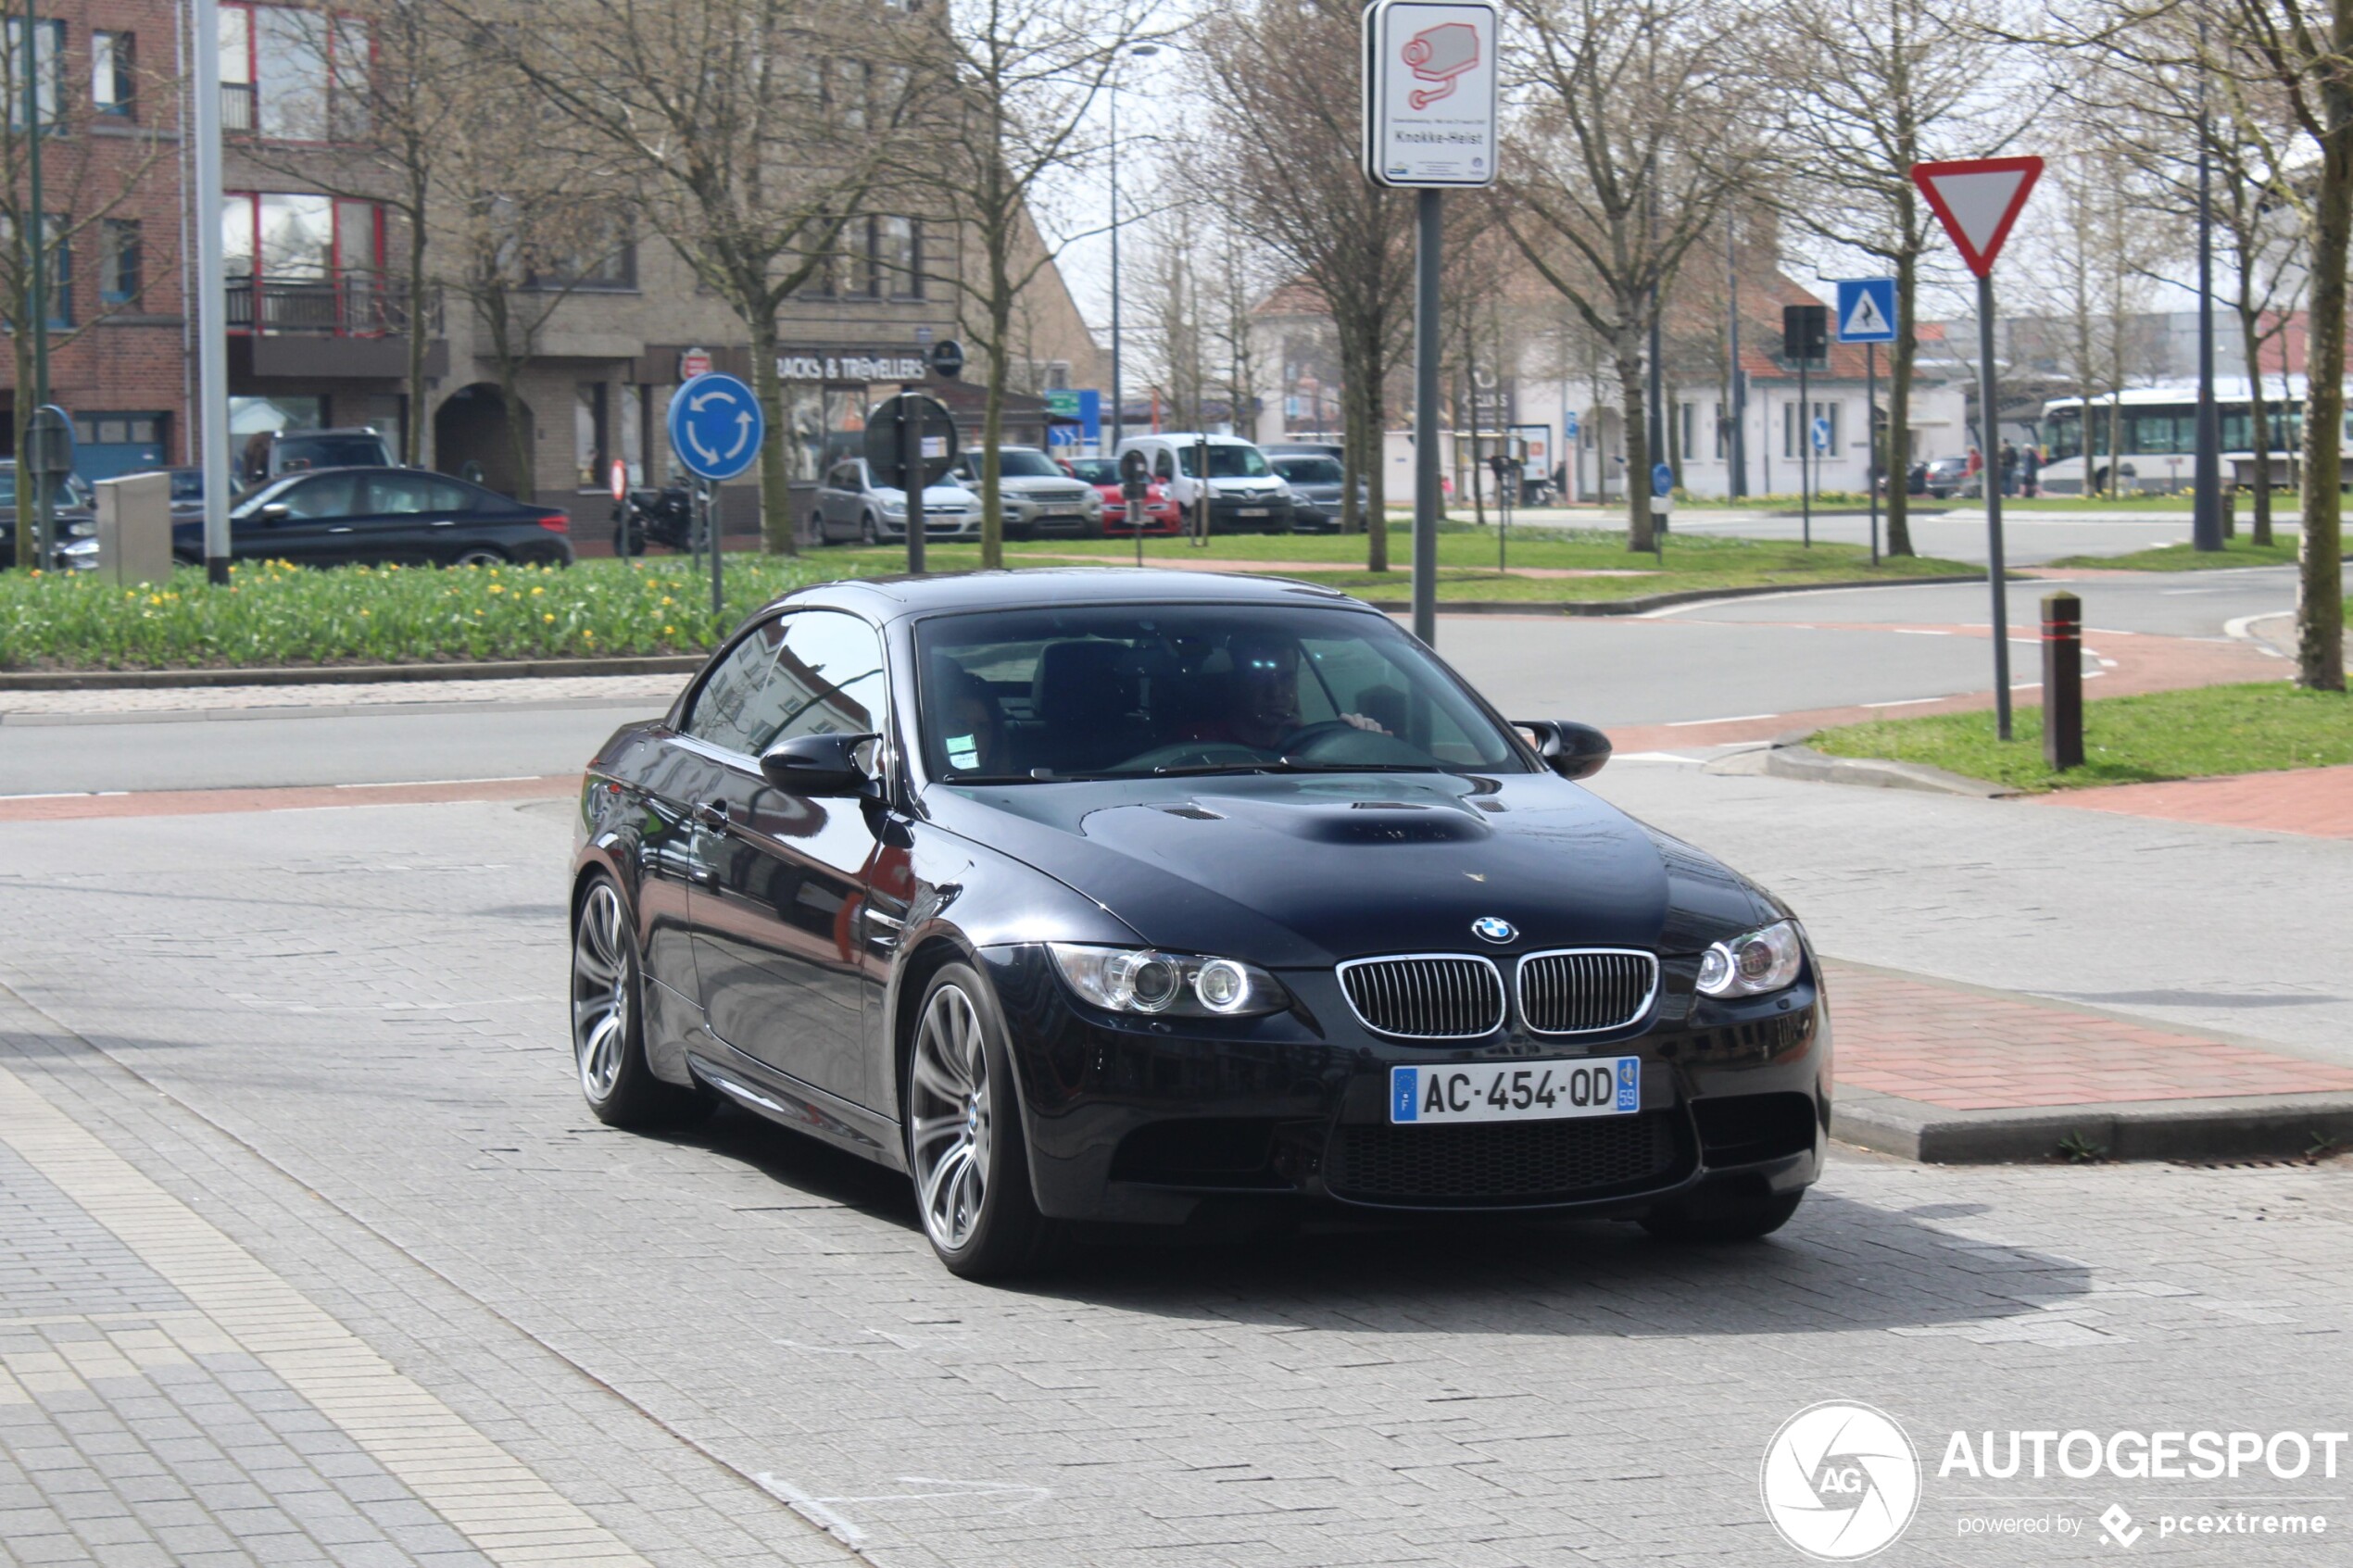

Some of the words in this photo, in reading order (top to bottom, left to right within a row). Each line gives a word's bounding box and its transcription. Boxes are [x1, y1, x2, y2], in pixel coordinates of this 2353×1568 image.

[1394, 131, 1483, 144] Knokke-Heist
[825, 358, 839, 379] &
[1618, 1089, 1635, 1107] 59
